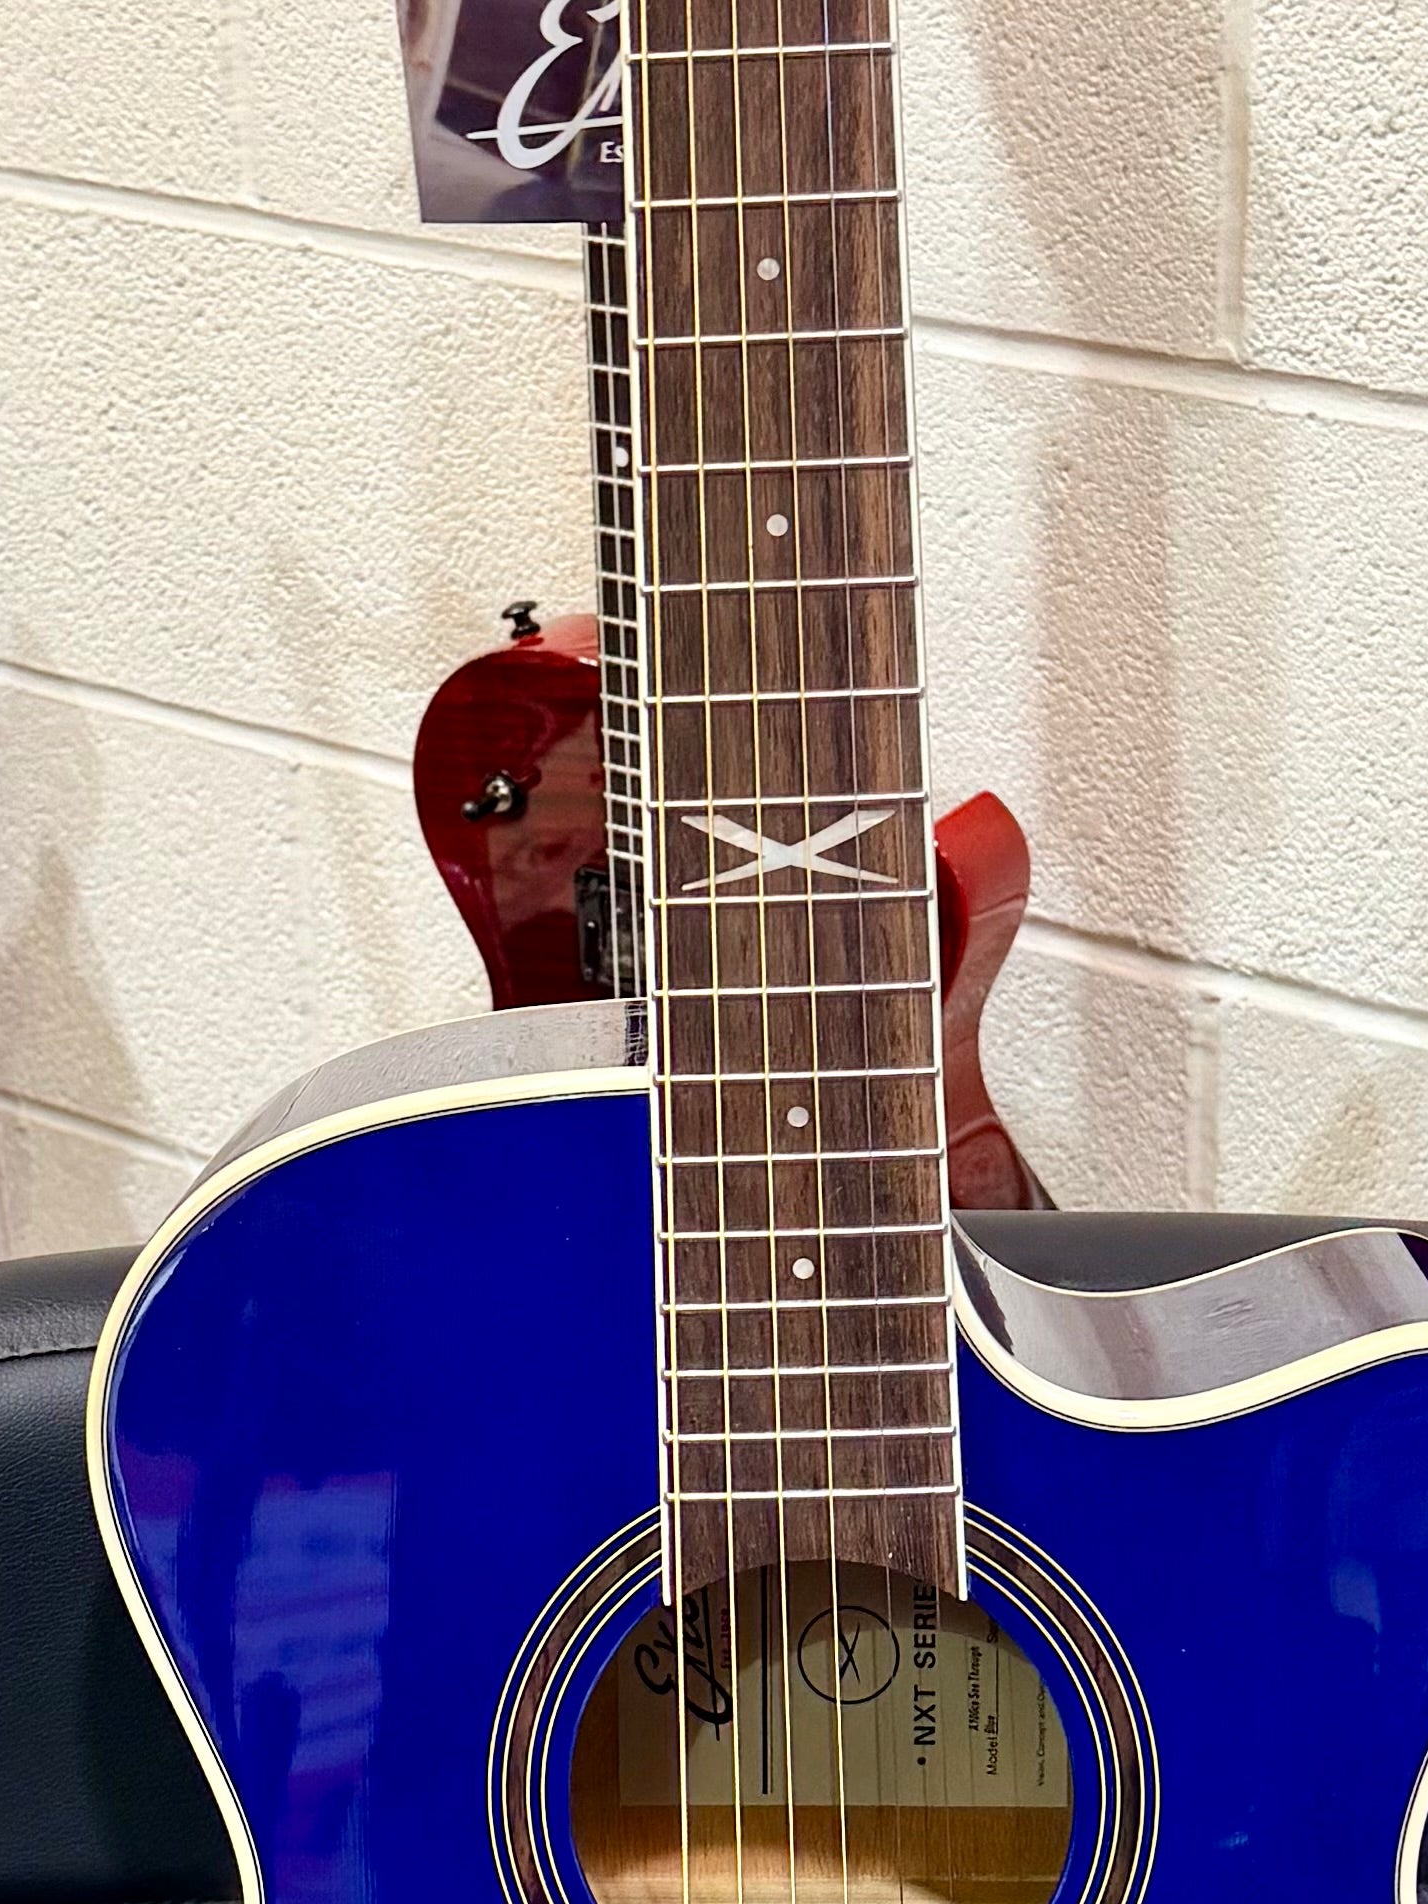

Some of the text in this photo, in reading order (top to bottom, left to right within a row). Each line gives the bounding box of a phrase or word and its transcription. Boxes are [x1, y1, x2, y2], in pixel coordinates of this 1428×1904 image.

[913, 1584, 937, 1669] SERIE
[913, 1684, 936, 1746] NXT
[985, 1736, 999, 1776] Model
